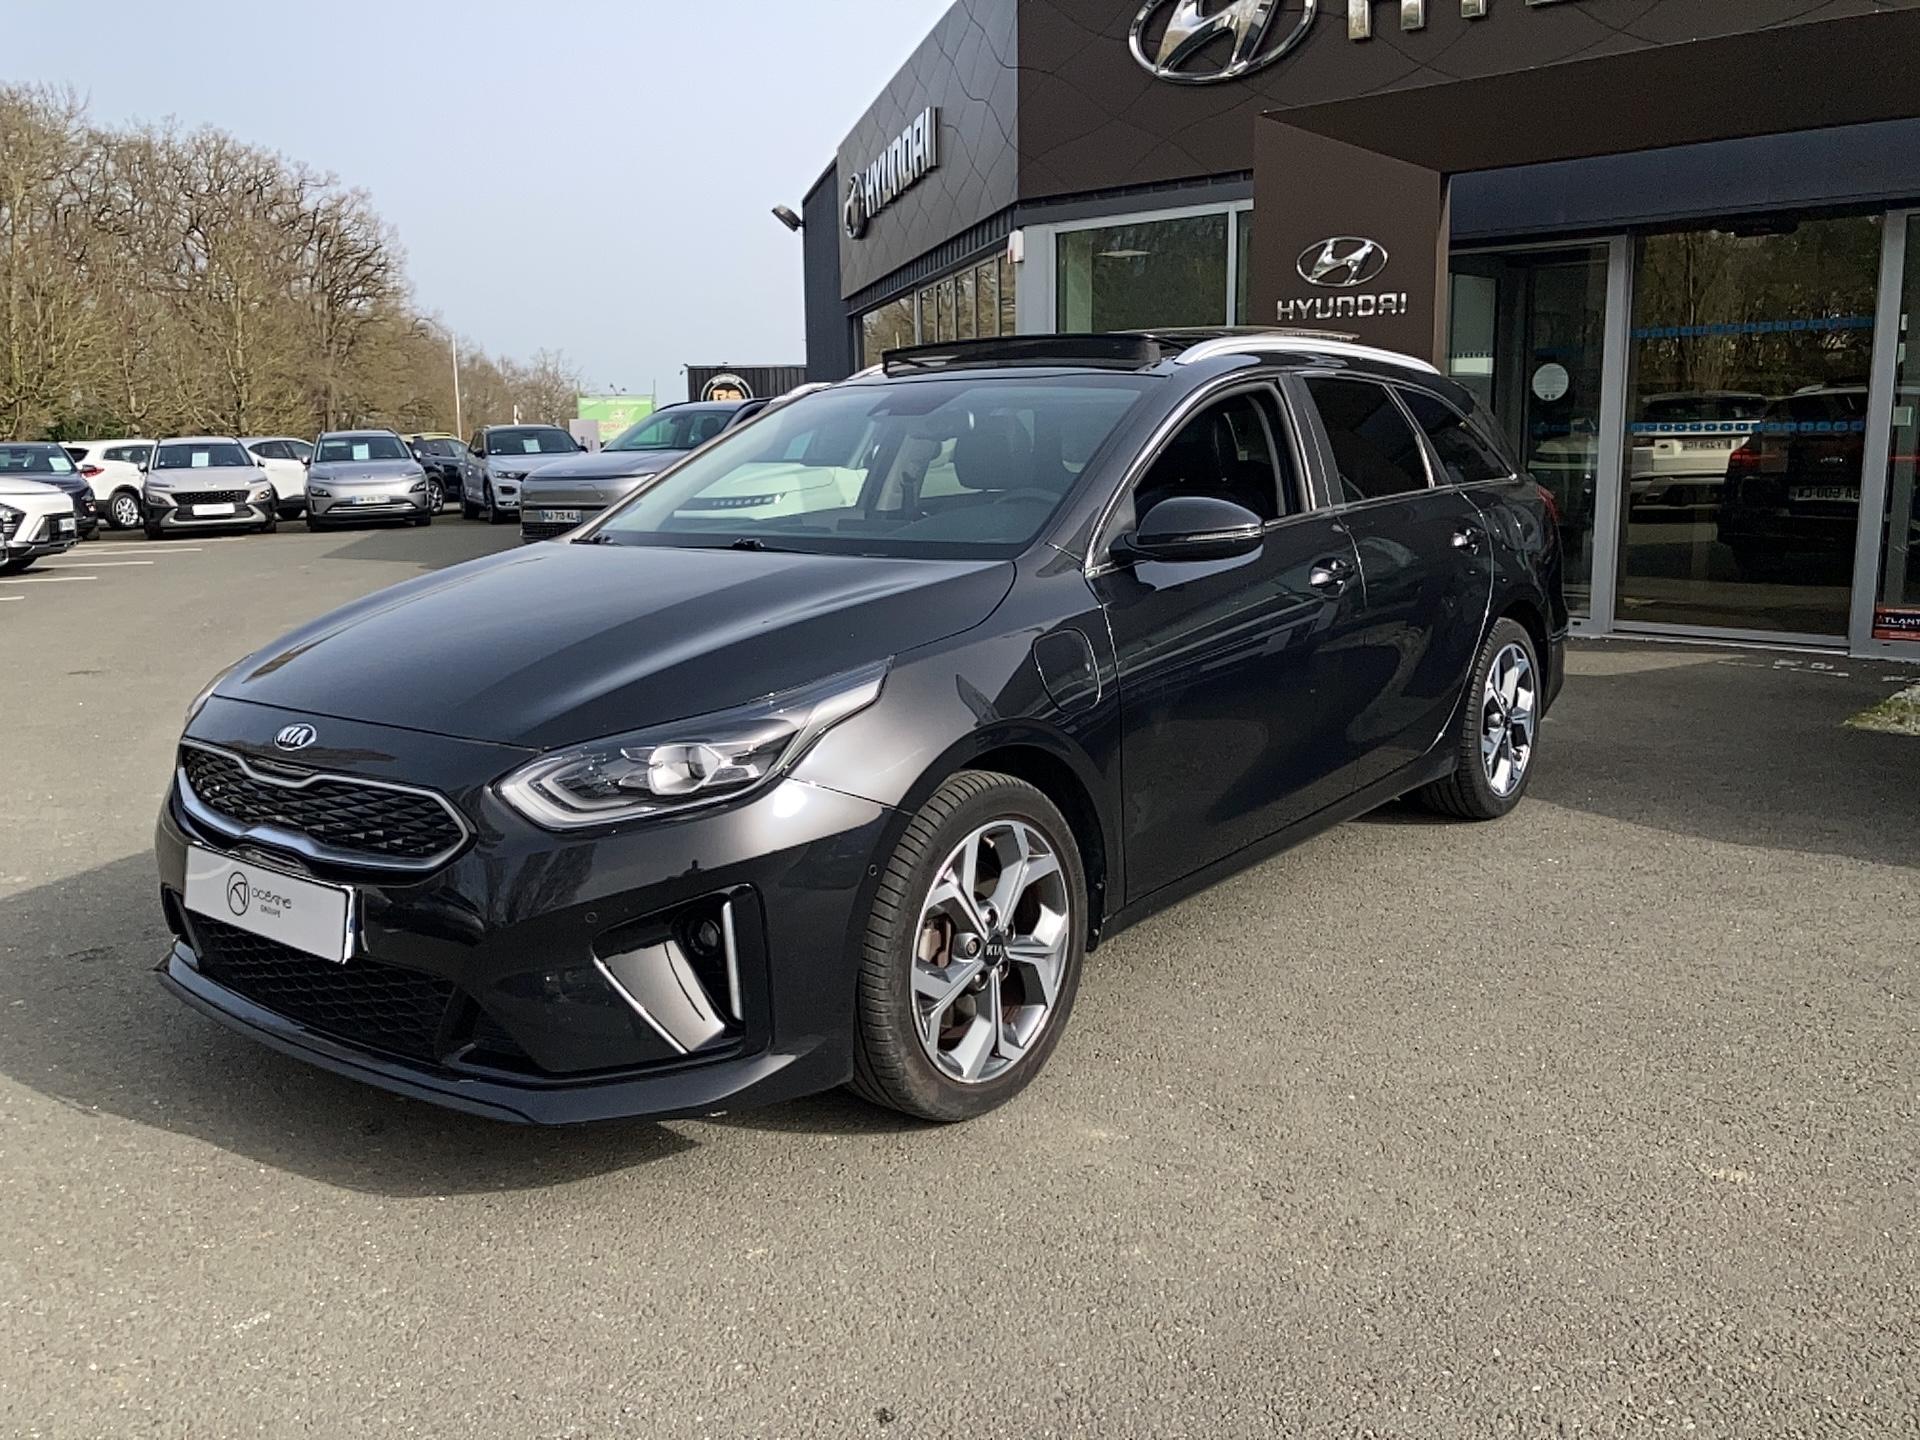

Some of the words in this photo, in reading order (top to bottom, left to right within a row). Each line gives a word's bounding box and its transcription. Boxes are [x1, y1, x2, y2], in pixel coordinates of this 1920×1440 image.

[865, 106, 936, 218] HYUNDAI
[1277, 292, 1407, 320] HYUNDAI
[277, 726, 310, 746] KIA
